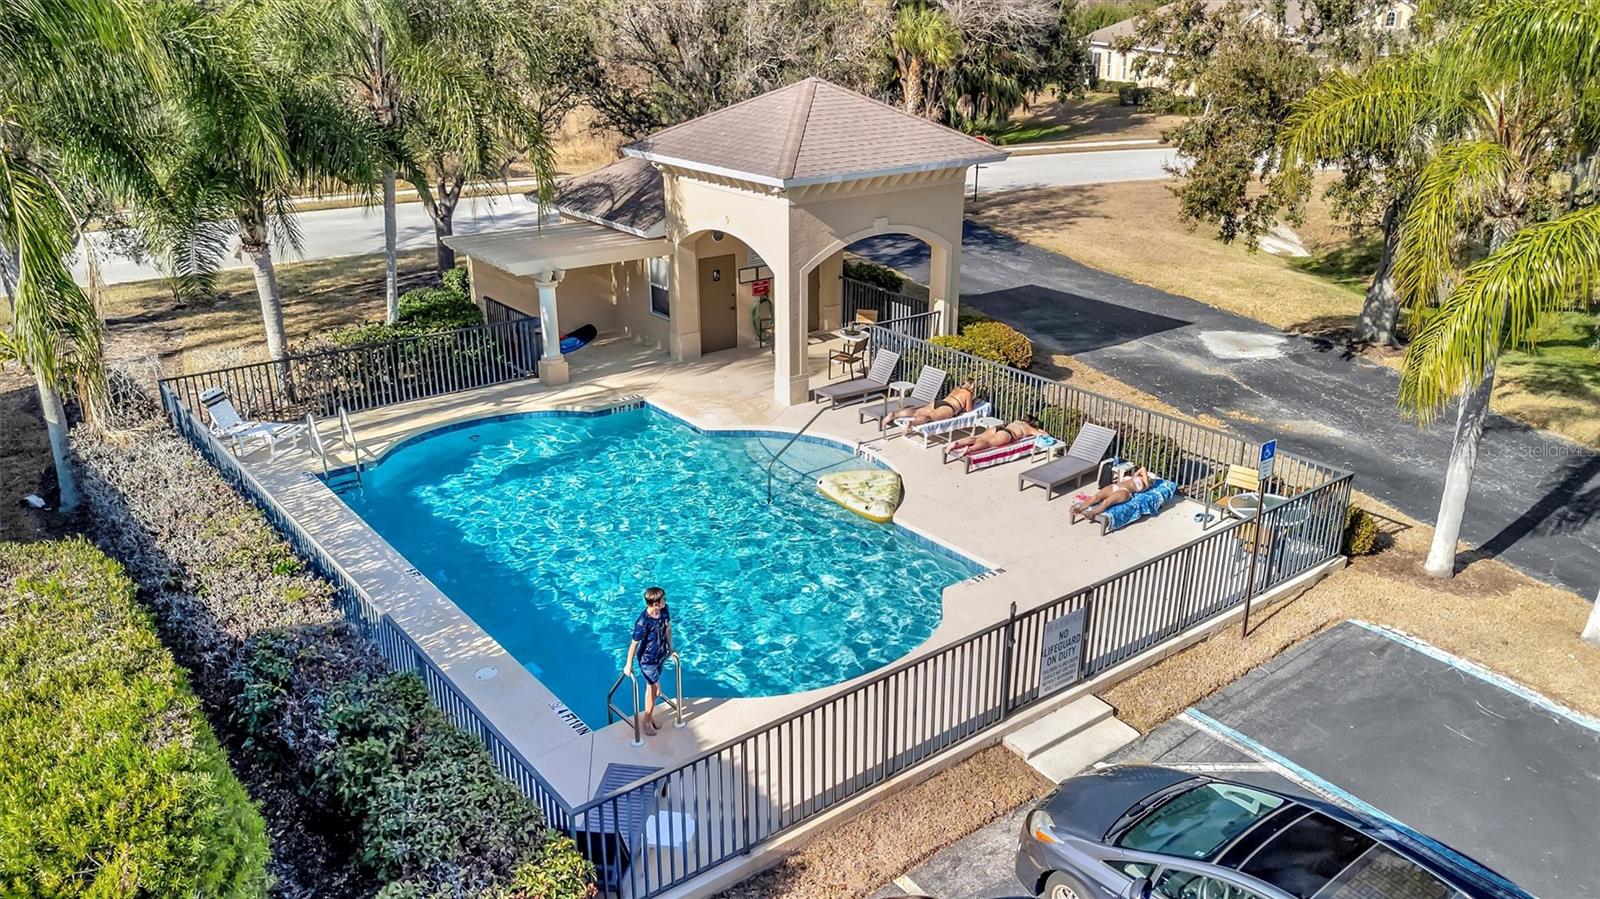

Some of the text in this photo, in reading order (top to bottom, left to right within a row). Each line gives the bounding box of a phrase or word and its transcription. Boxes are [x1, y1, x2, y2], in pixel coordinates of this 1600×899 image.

[1058, 629, 1069, 641] NO
[1044, 634, 1081, 657] LIFEGUARD
[1046, 656, 1056, 666] ON
[1058, 645, 1076, 661] DUTY
[561, 713, 578, 723] FT
[568, 719, 585, 729] 10
[575, 725, 592, 736] IN
